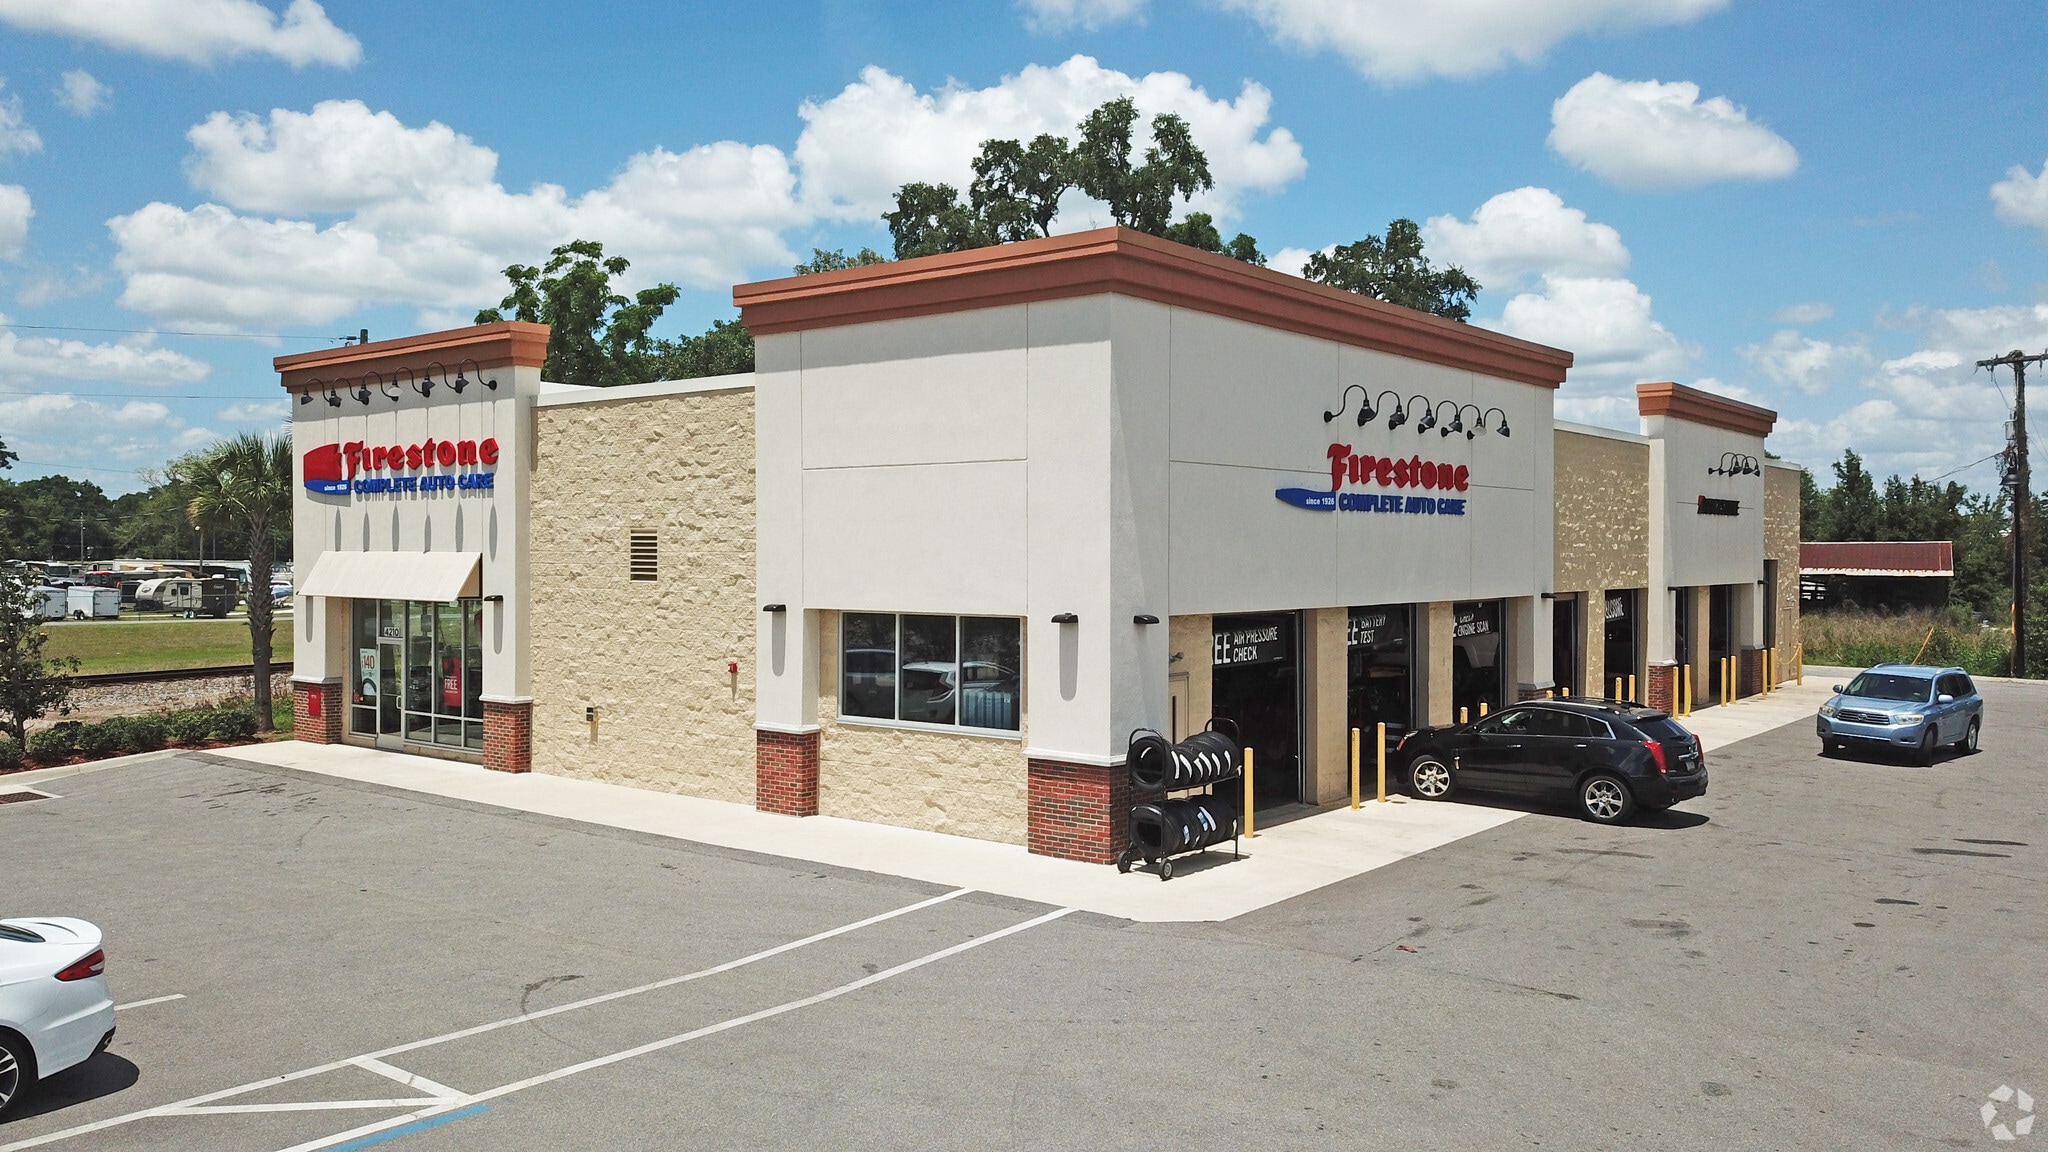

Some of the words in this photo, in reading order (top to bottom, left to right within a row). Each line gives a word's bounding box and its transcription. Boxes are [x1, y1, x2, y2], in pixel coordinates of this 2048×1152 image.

[343, 437, 499, 480] Firestone
[1327, 443, 1469, 492] Firestone
[353, 476, 417, 494] COMPLETE
[419, 474, 455, 491] AUTO
[457, 472, 494, 489] CARE
[1306, 497, 1320, 505] since
[1321, 497, 1335, 505] 1926
[1338, 493, 1403, 513] COMPLETE
[1404, 496, 1436, 515] AUTO
[1437, 498, 1467, 516] CARE
[1233, 632, 1245, 645] AIR
[1245, 626, 1278, 644] PRESSURE
[1476, 620, 1489, 633] SCAN
[1360, 629, 1375, 644] TEST
[1233, 645, 1258, 663] CHECK
[444, 678, 458, 690] FREE
